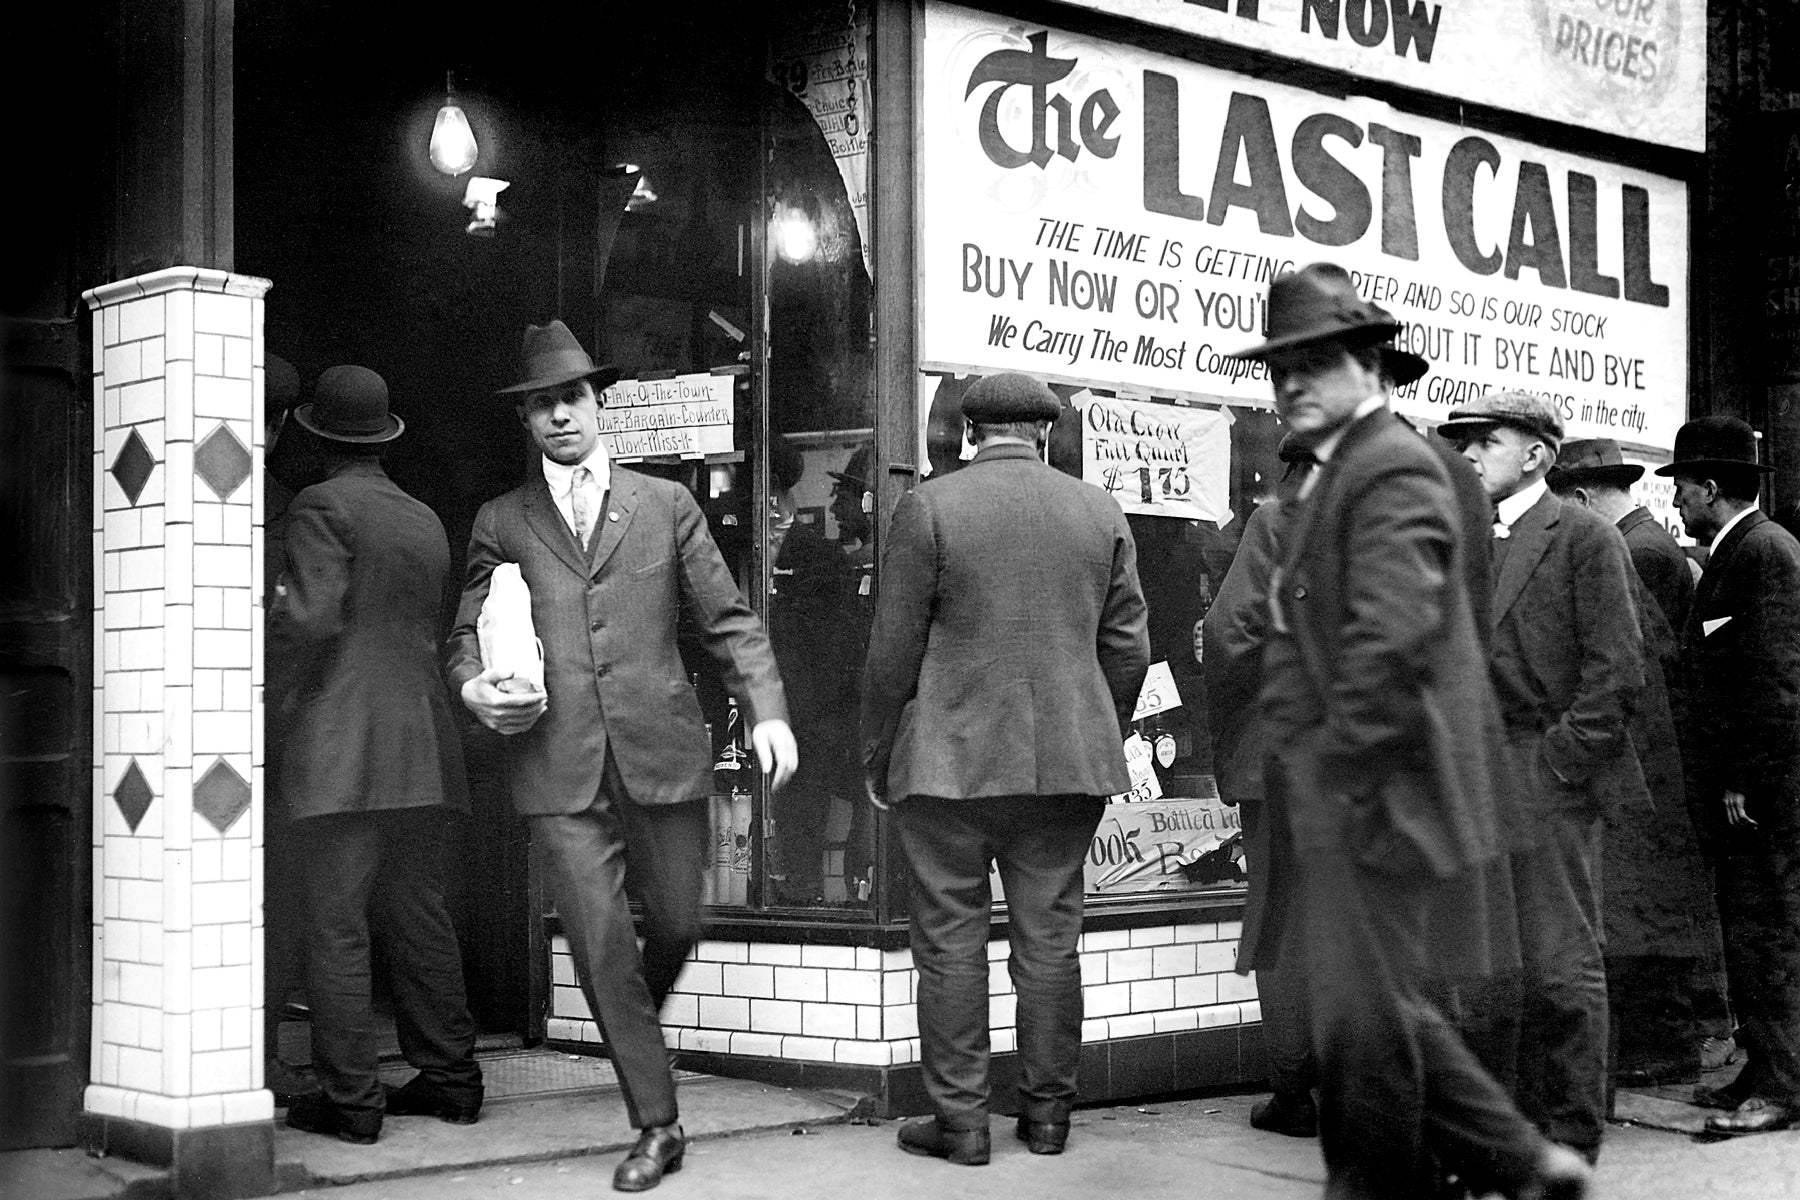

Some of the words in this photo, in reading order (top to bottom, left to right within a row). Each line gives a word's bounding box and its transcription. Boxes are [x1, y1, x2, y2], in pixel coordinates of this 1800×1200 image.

[1301, 0, 1441, 63] NOW
[1555, 14, 1657, 83] PRICES
[964, 31, 1121, 170] The
[1143, 69, 1421, 261] LAST
[1442, 136, 1670, 307] CALL
[1036, 217, 1084, 252] THE
[1093, 227, 1150, 262] TIME
[1158, 239, 1183, 268] IS
[1351, 270, 1398, 302] RTER
[1403, 282, 1441, 311] AND
[1449, 290, 1475, 316] SO
[1481, 296, 1498, 321] IS
[1503, 300, 1542, 328] OUR
[1550, 308, 1608, 339] STOCK
[962, 243, 1033, 300] BUY
[1049, 258, 1118, 313] NOW
[1135, 279, 1180, 324] OR
[1398, 320, 1454, 363] HOUT
[1464, 332, 1481, 366] IT
[1496, 337, 1540, 375] BYE
[1549, 346, 1595, 382] AND
[1604, 353, 1646, 390] BYE
[988, 314, 1018, 348] We
[1023, 320, 1084, 365] Carry
[1090, 328, 1128, 362] The
[1132, 335, 1187, 369] Most
[1195, 343, 1271, 385] Complet
[1581, 398, 1593, 422] in
[1596, 399, 1618, 426] the
[1621, 404, 1648, 433] city.
[1087, 437, 1131, 462] Full
[1135, 440, 1191, 466] Quart
[1088, 402, 1128, 435] Old
[1147, 808, 1216, 833] Bottled
